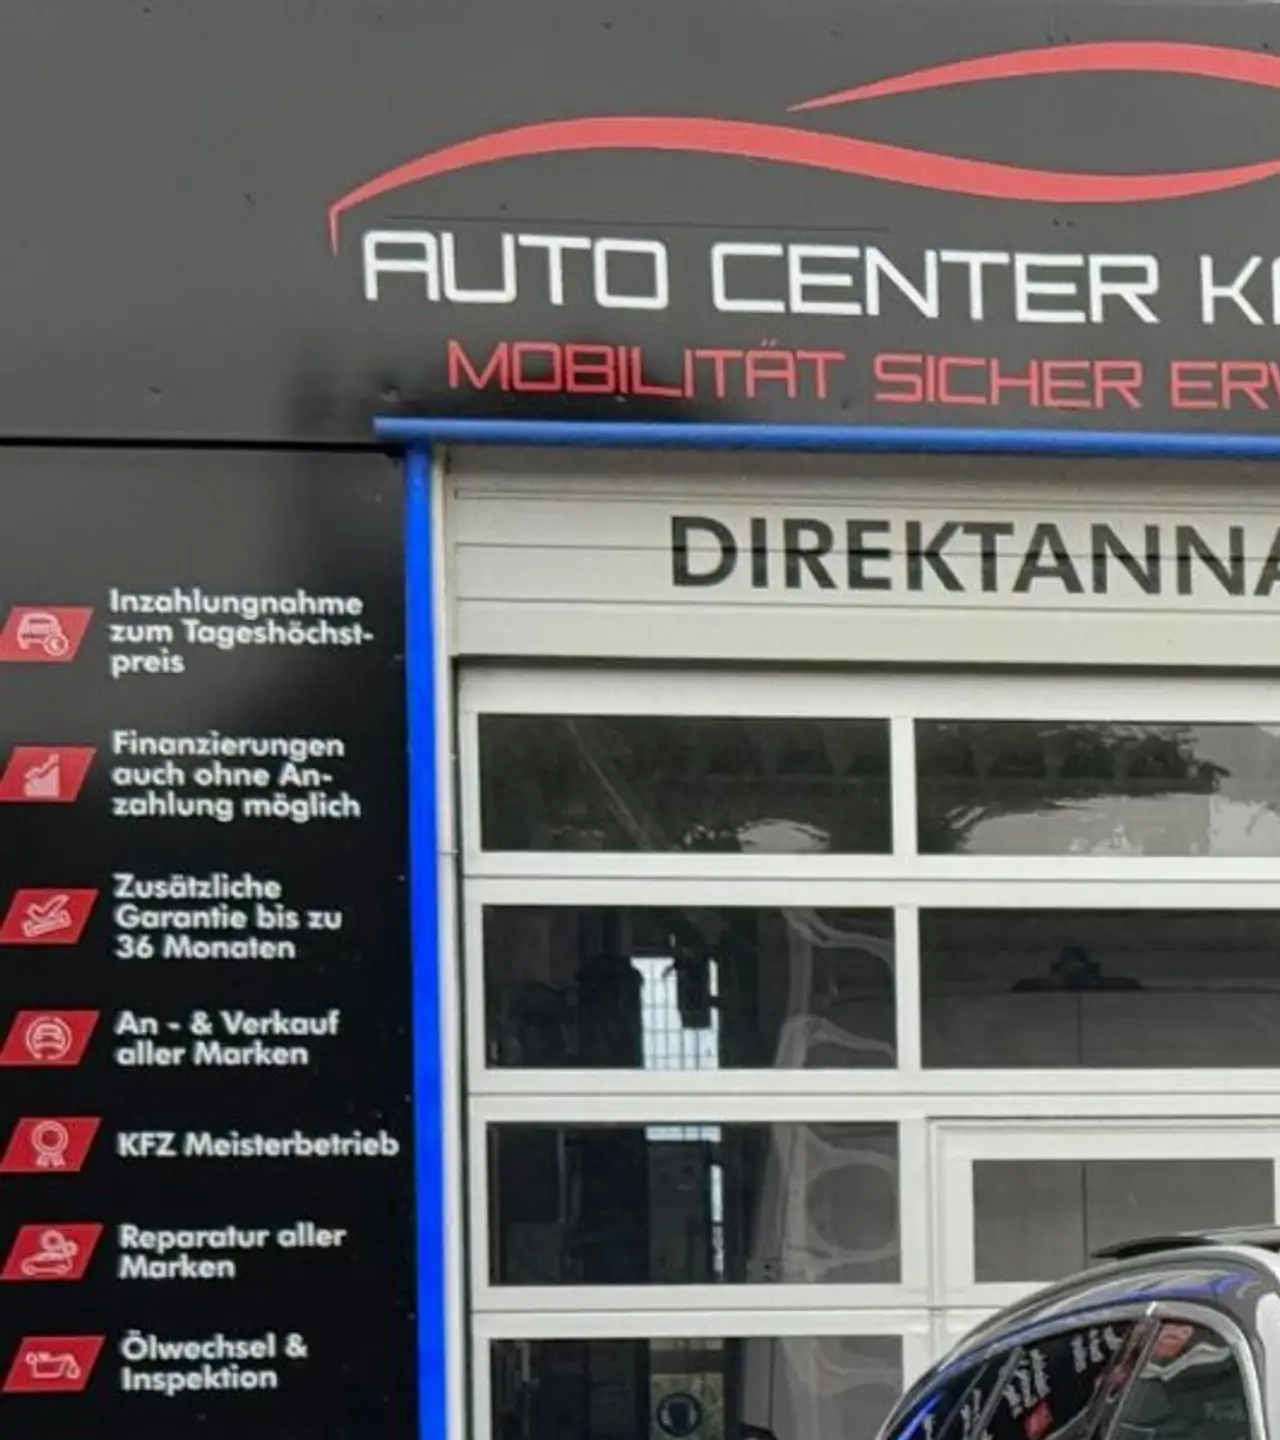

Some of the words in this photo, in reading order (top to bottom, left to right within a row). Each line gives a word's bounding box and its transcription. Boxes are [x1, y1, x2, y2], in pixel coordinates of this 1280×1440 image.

[364, 231, 668, 309] AUTO
[711, 243, 1160, 323] CENTER
[447, 339, 844, 398] MOBILITÄT
[872, 353, 1144, 410] SICHER
[110, 588, 362, 618] Inzahlungnahme
[110, 624, 173, 643] zum
[184, 619, 374, 647] Tageshöchst-
[111, 648, 185, 678] preis
[112, 729, 344, 762] Finanzierungen
[112, 760, 184, 788] auch
[194, 760, 270, 786] ohne
[279, 762, 332, 786] An-
[113, 790, 233, 822] zahlung
[244, 792, 360, 823] möglich
[114, 873, 281, 901] Zusätzliche
[115, 903, 247, 932] Garantie
[256, 904, 299, 929] bis
[308, 911, 342, 930] zu
[116, 934, 154, 958] 36
[163, 934, 295, 959] Monaten
[190, 1011, 212, 1035] &
[220, 1010, 339, 1037] Verkauf
[116, 1040, 186, 1065] aller
[194, 1040, 308, 1065] Marken
[118, 1132, 176, 1156] KFZ
[184, 1130, 399, 1156] Meisterbetrieb
[120, 1224, 270, 1254] Reparatur
[277, 1222, 346, 1247] aller
[119, 1254, 235, 1278] Marken
[121, 1330, 276, 1363] Ölwechsel
[285, 1333, 307, 1357] &
[122, 1364, 277, 1396] Inspektion
